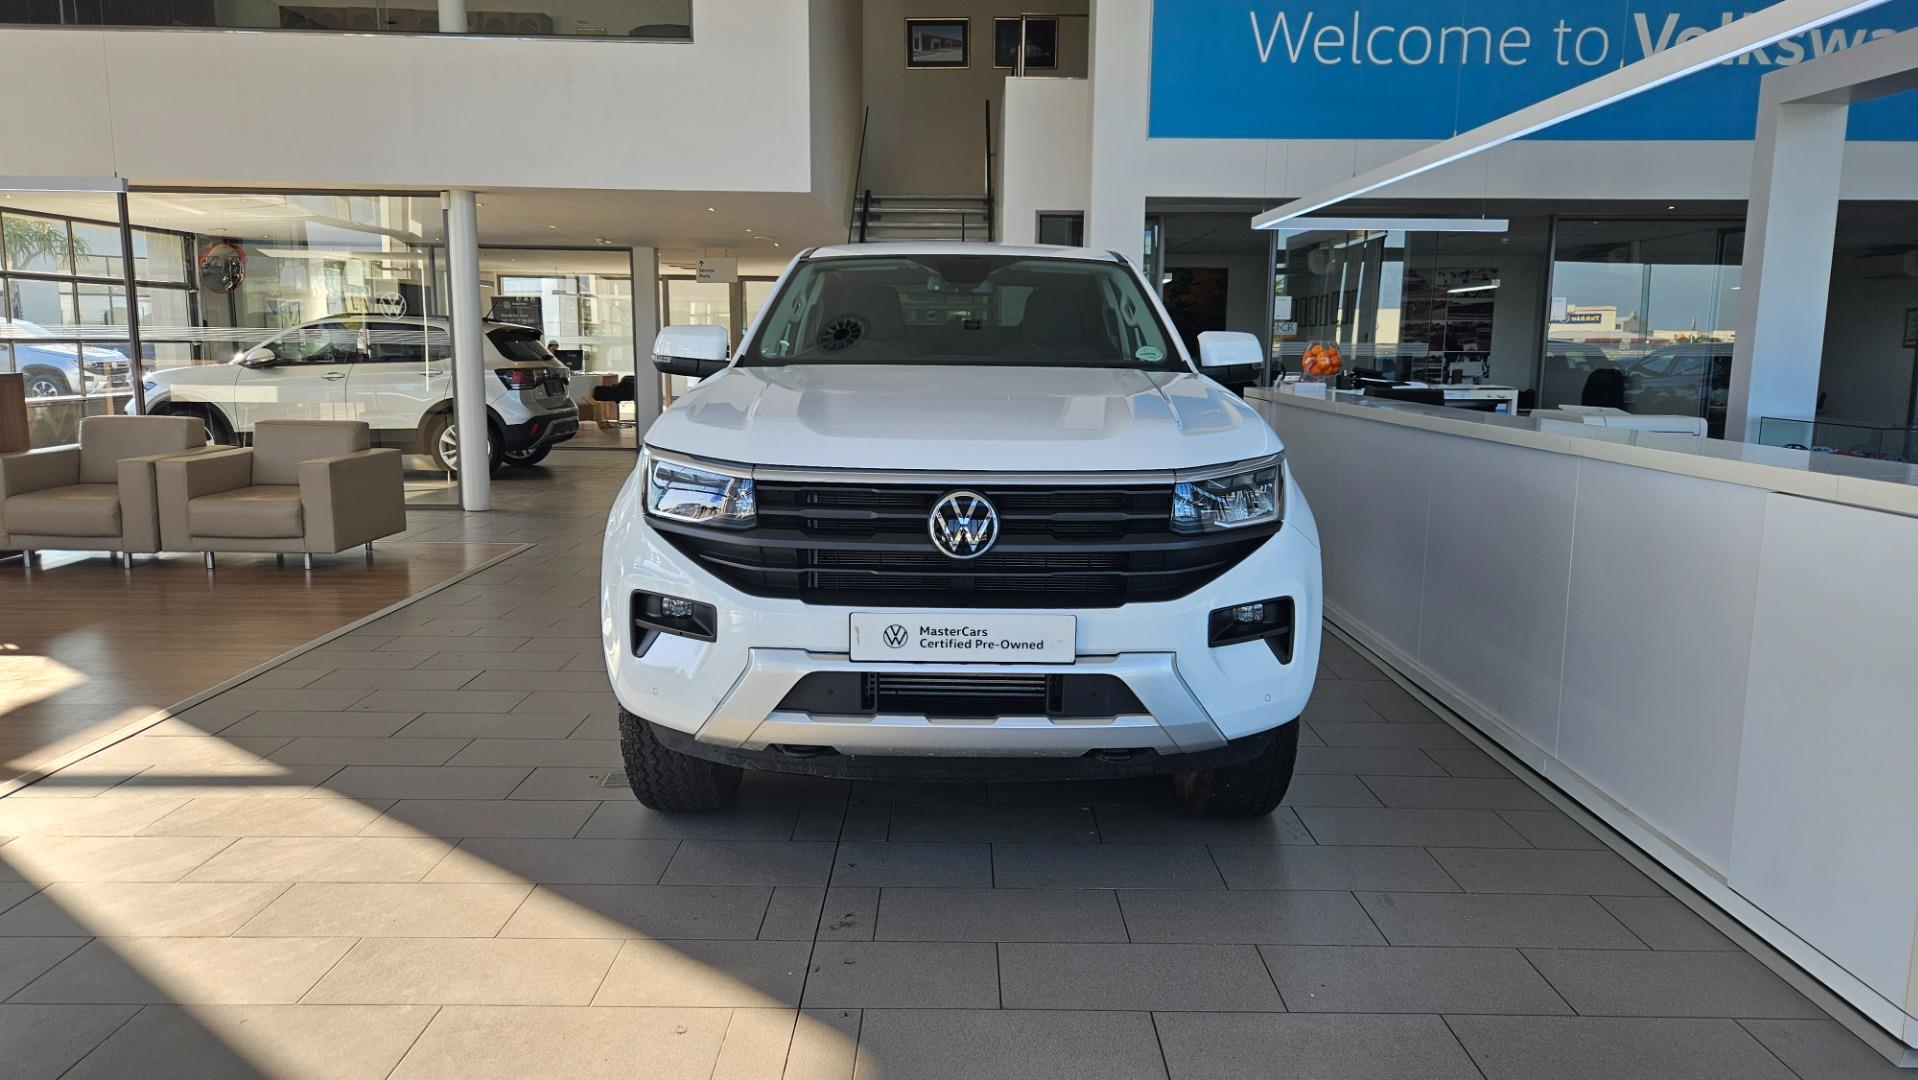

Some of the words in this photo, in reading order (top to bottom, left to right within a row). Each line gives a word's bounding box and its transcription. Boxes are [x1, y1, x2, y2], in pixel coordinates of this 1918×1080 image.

[1249, 11, 1531, 65] Welcome
[1553, 19, 1609, 66] to
[919, 626, 988, 637] MasterCars
[919, 638, 972, 649] Certified
[975, 639, 1044, 650] Pre-Owned
